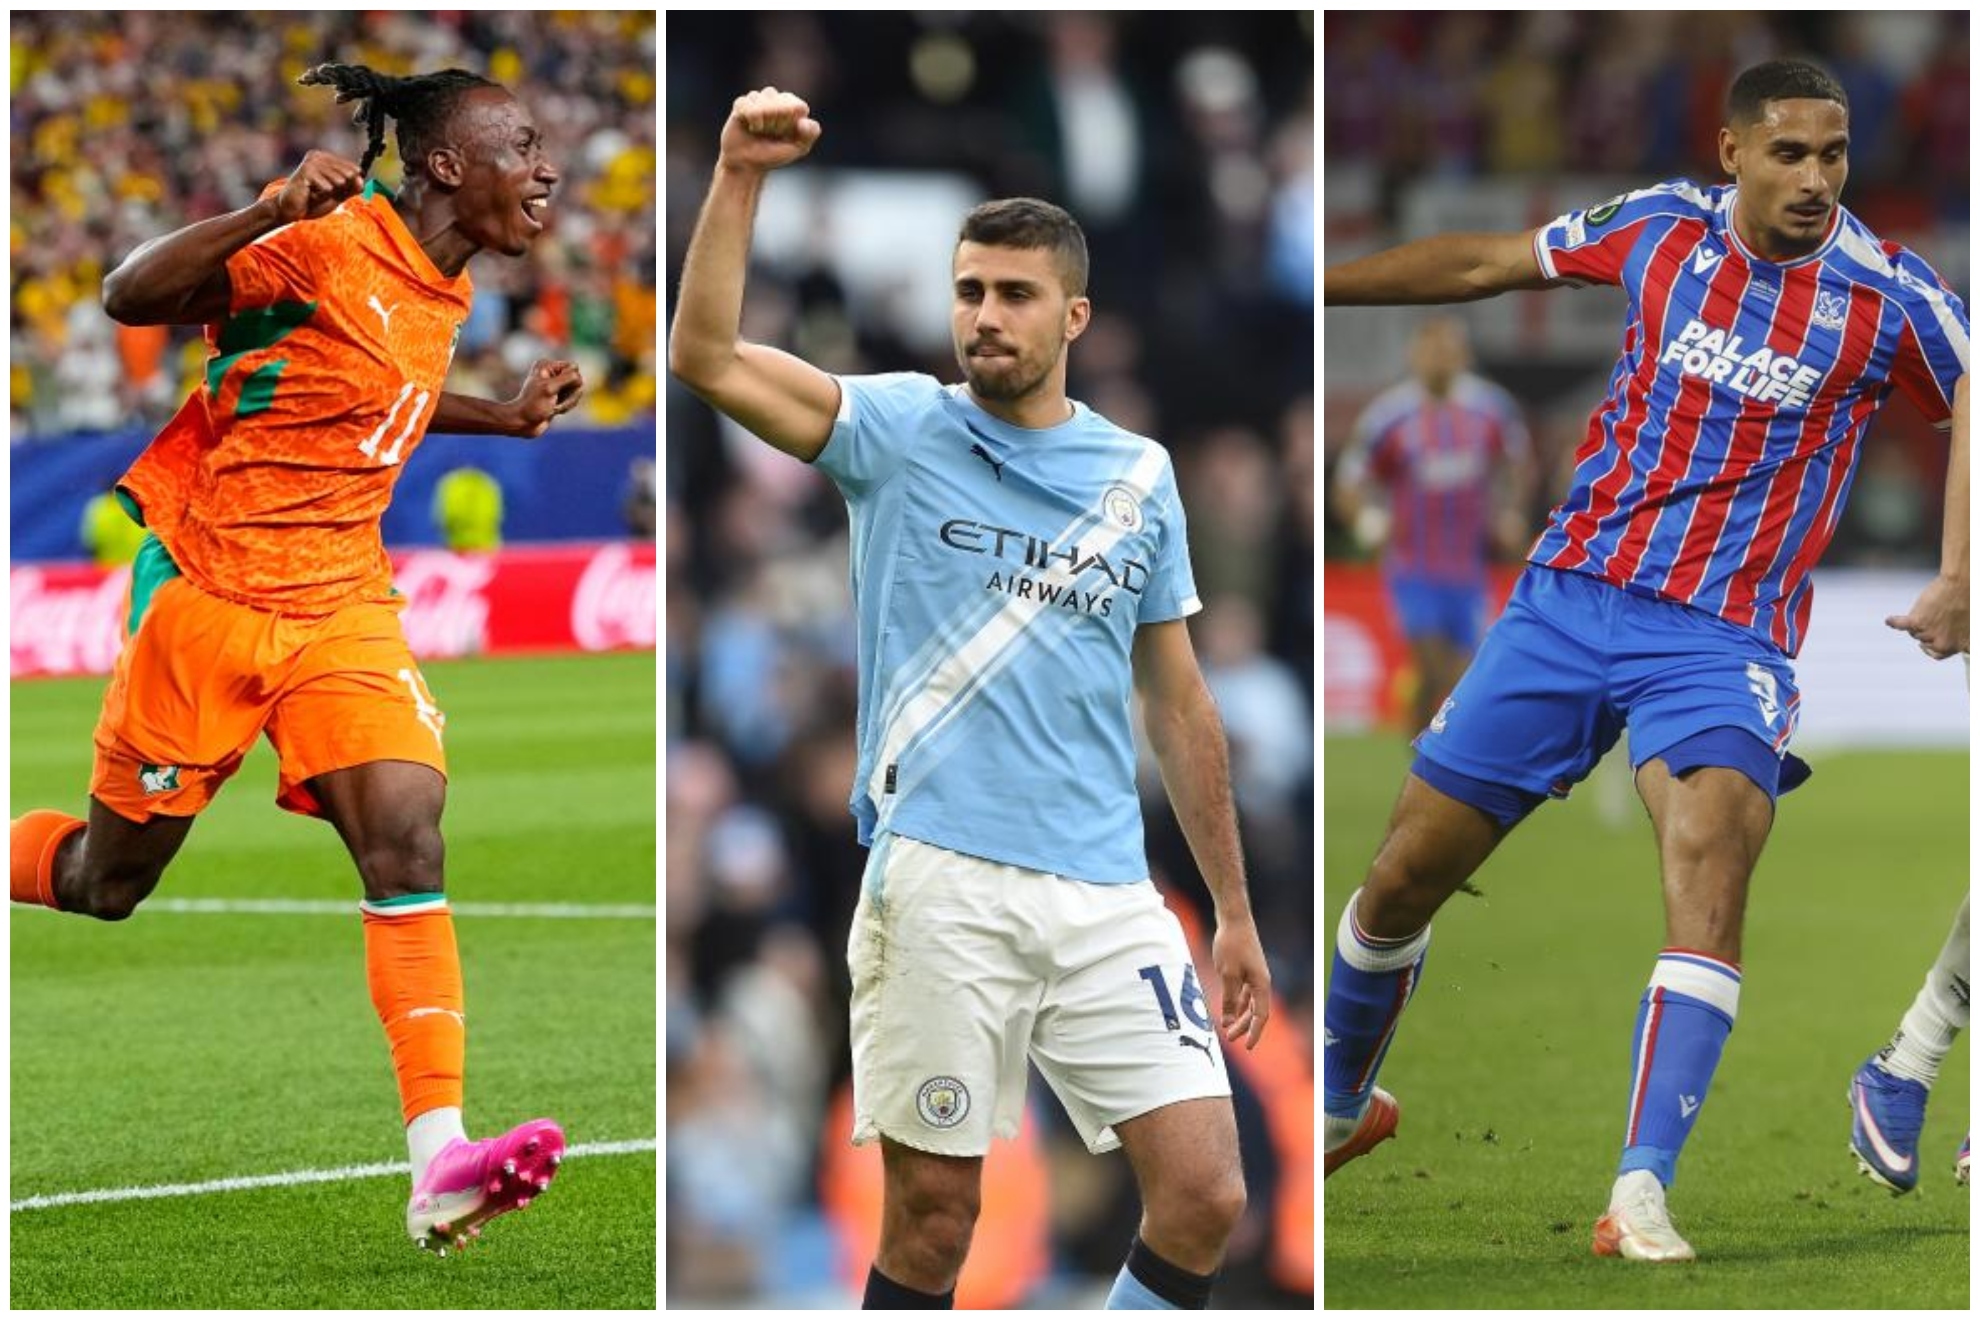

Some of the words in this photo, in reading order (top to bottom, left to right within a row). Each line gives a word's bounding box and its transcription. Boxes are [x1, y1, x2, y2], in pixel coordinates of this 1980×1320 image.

[1661, 340, 1733, 384] FOR
[1728, 366, 1811, 408] LIFE
[1678, 319, 1822, 391] PALACE
[358, 381, 430, 465] 11
[939, 519, 1149, 595] ETIHAD
[986, 571, 1113, 617] AIRWAYS
[1137, 963, 1214, 1032] 16
